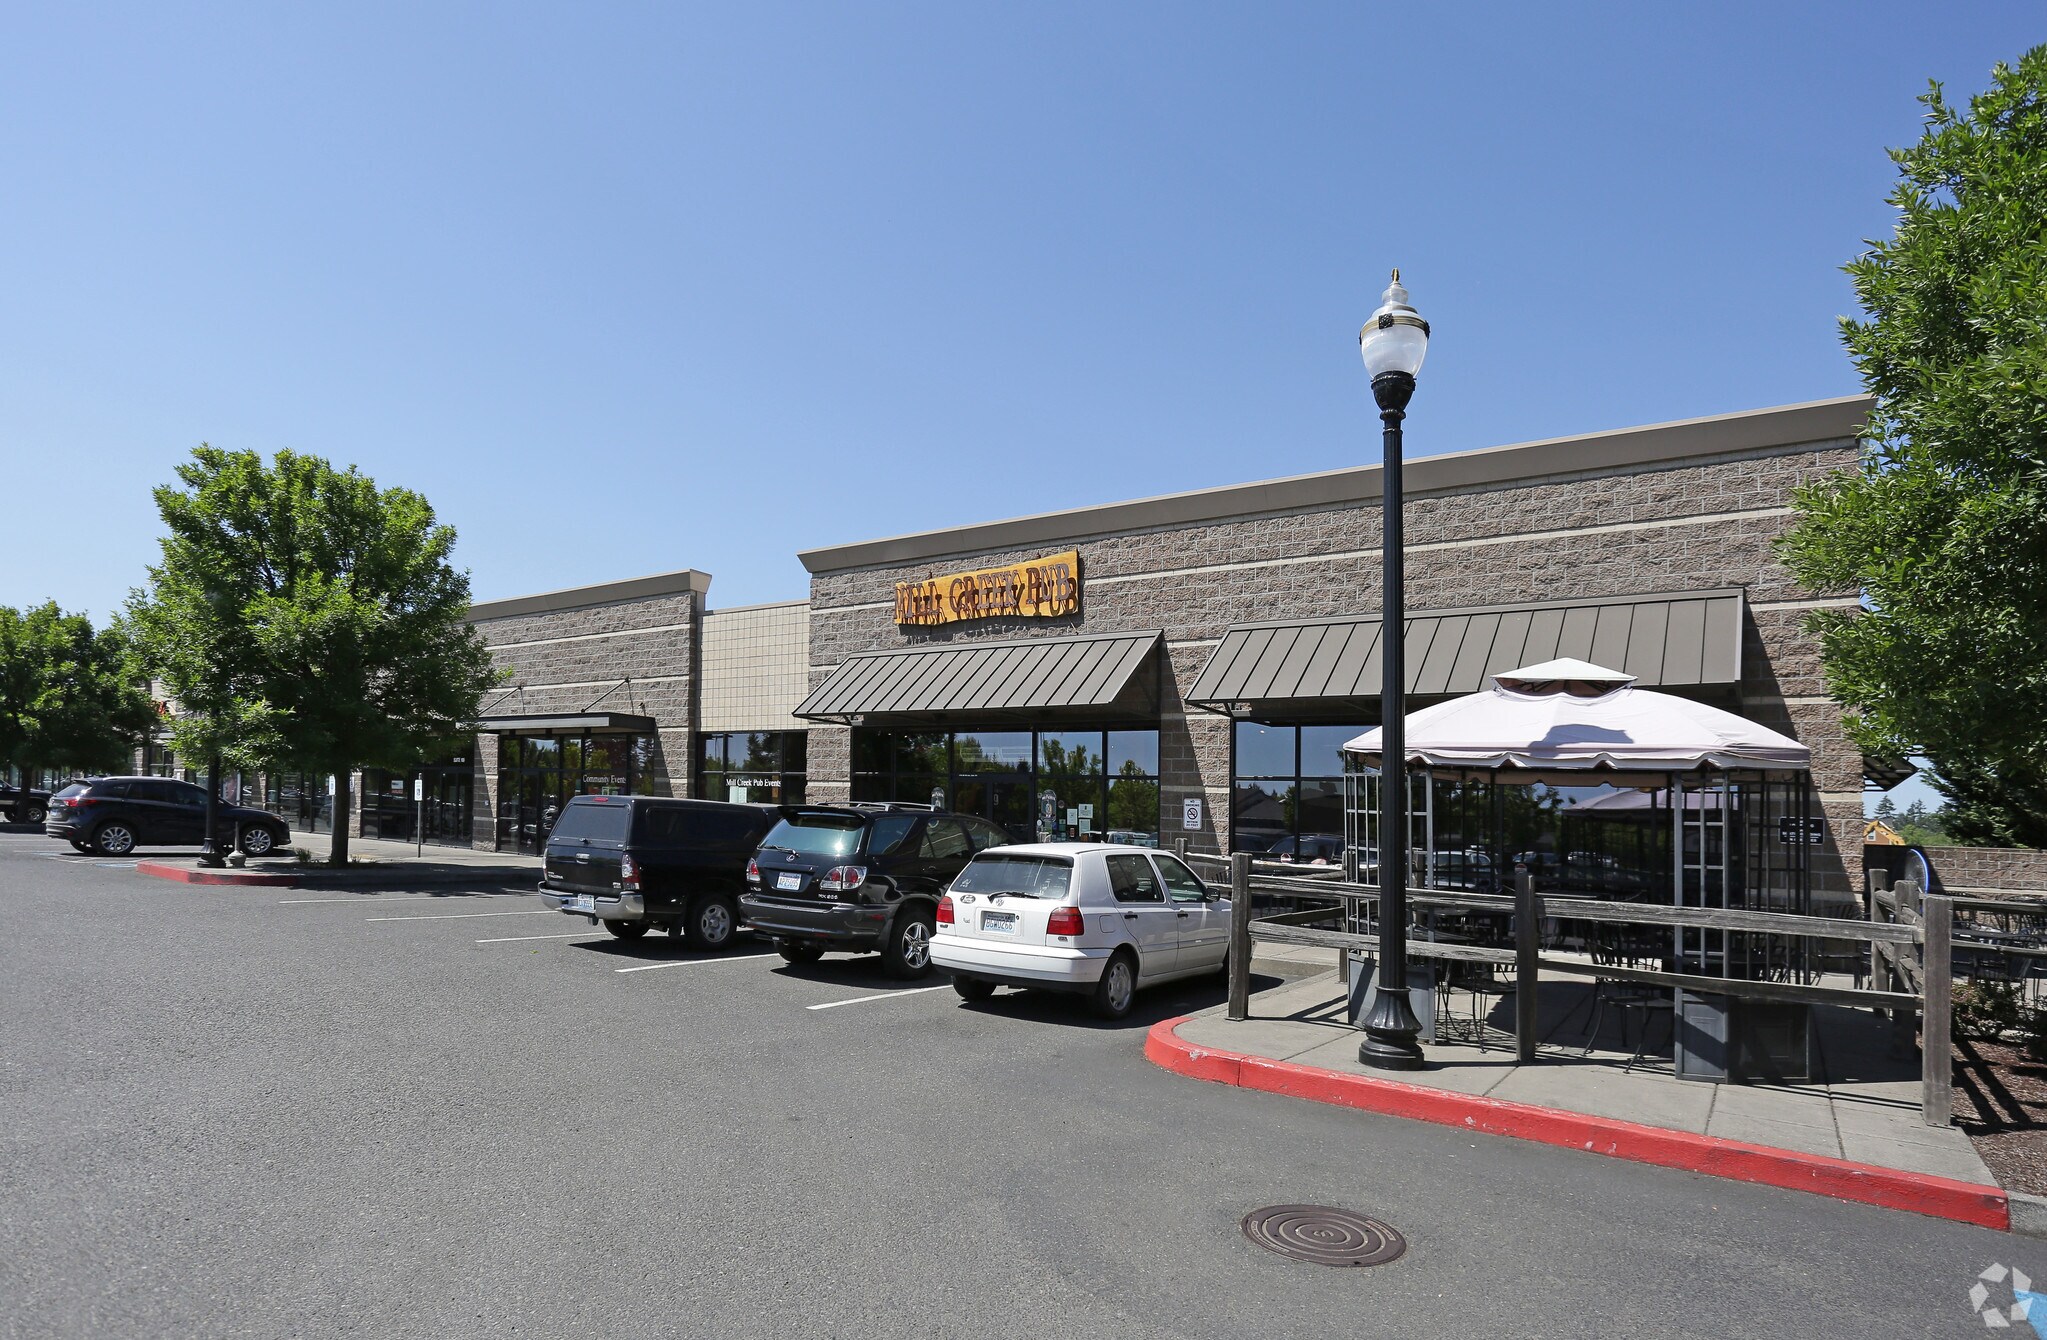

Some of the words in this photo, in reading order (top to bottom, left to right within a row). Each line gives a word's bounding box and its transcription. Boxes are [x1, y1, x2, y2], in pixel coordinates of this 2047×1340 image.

[894, 581, 940, 619] MILL
[950, 569, 1020, 613] CREEK
[1026, 563, 1070, 604] PUB
[583, 774, 609, 785] Community
[610, 774, 626, 783] Events
[726, 778, 736, 786] Mill
[737, 778, 752, 786] Creek
[753, 778, 763, 786] Pub
[764, 778, 781, 787] Events
